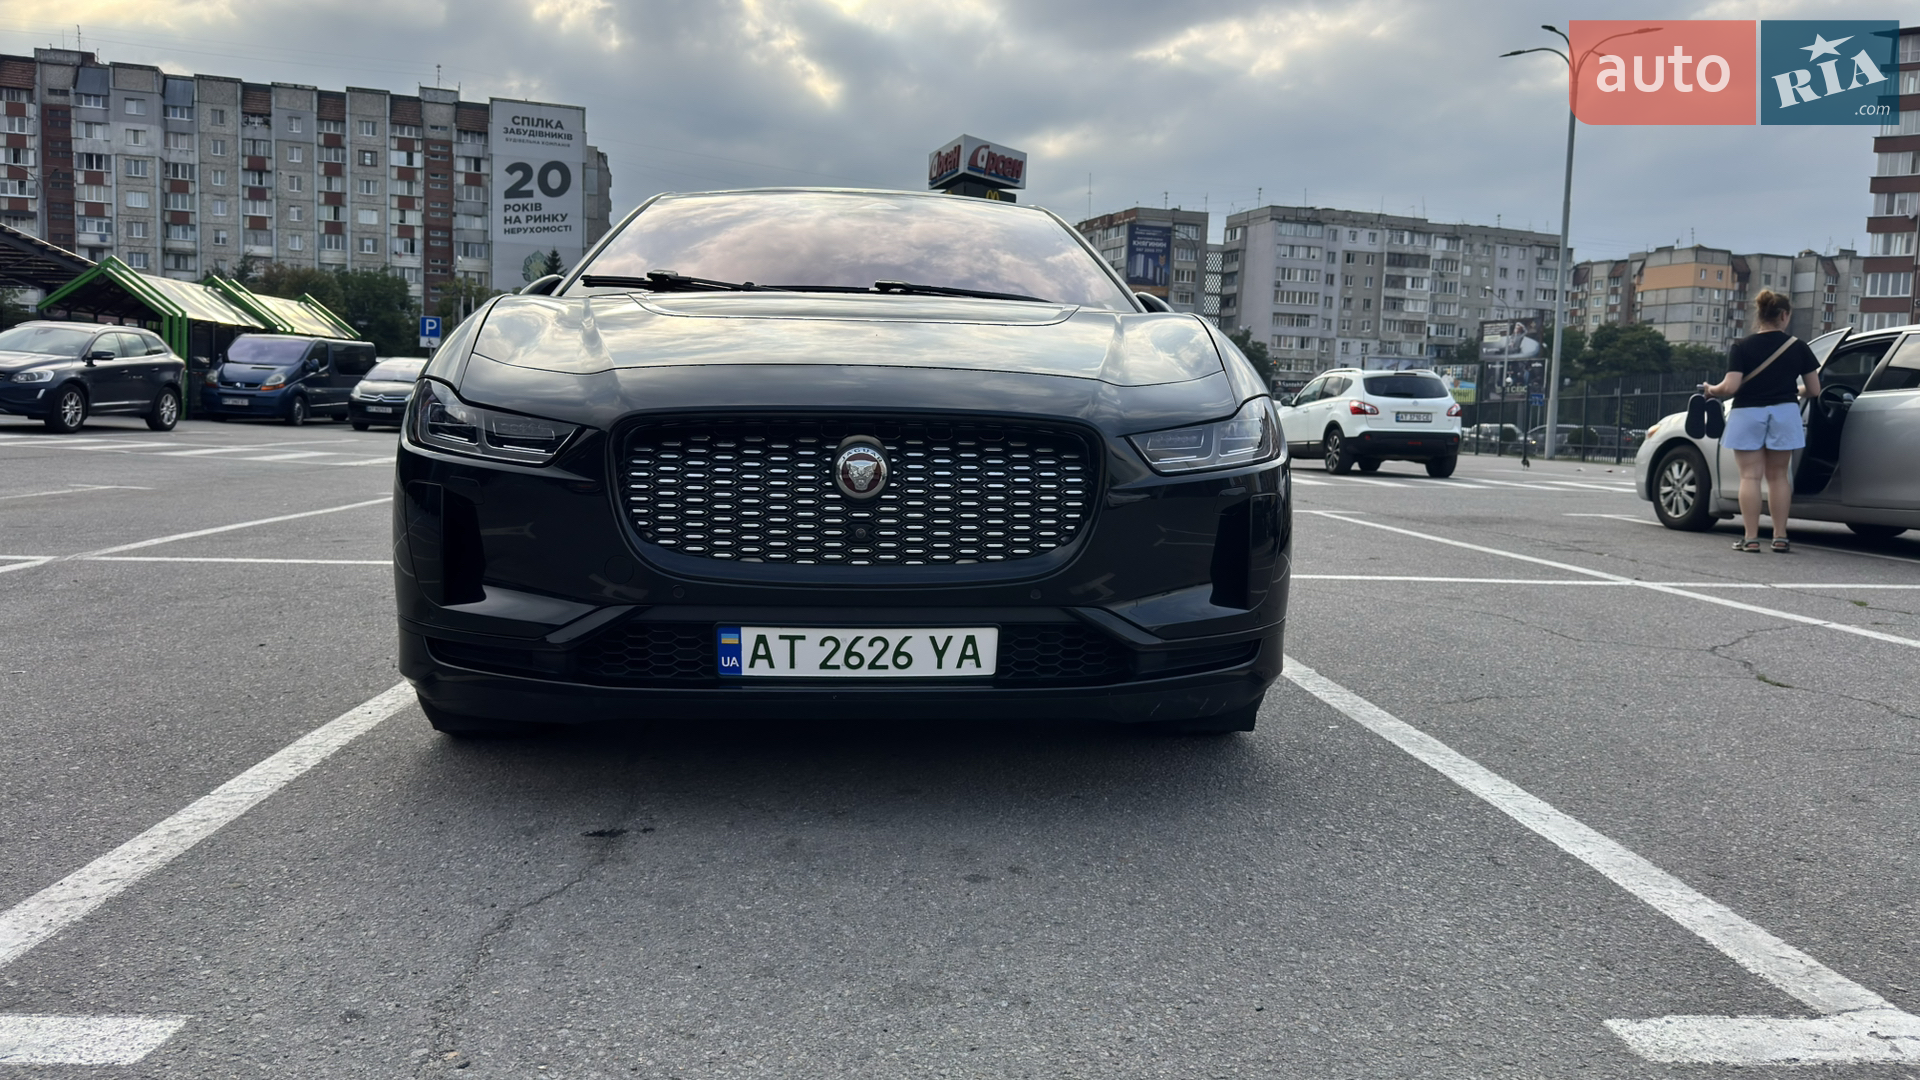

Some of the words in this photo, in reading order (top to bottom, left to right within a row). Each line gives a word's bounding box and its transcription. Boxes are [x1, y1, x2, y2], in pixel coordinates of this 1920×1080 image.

[511, 115, 564, 130] СПІЛКА
[503, 127, 573, 141] ЗАБУДІВНИКІВ
[504, 161, 572, 199] 20
[504, 202, 543, 213] РОКІВ
[504, 215, 522, 225] НА
[525, 213, 568, 224] РИНКУ
[504, 225, 572, 235] НЕРУХОМОСТІ
[426, 319, 437, 335] P
[841, 448, 883, 462] JAGUAR
[748, 634, 806, 669] AT
[819, 636, 913, 670] 2626
[929, 635, 982, 669] YA
[721, 657, 739, 667] UA
